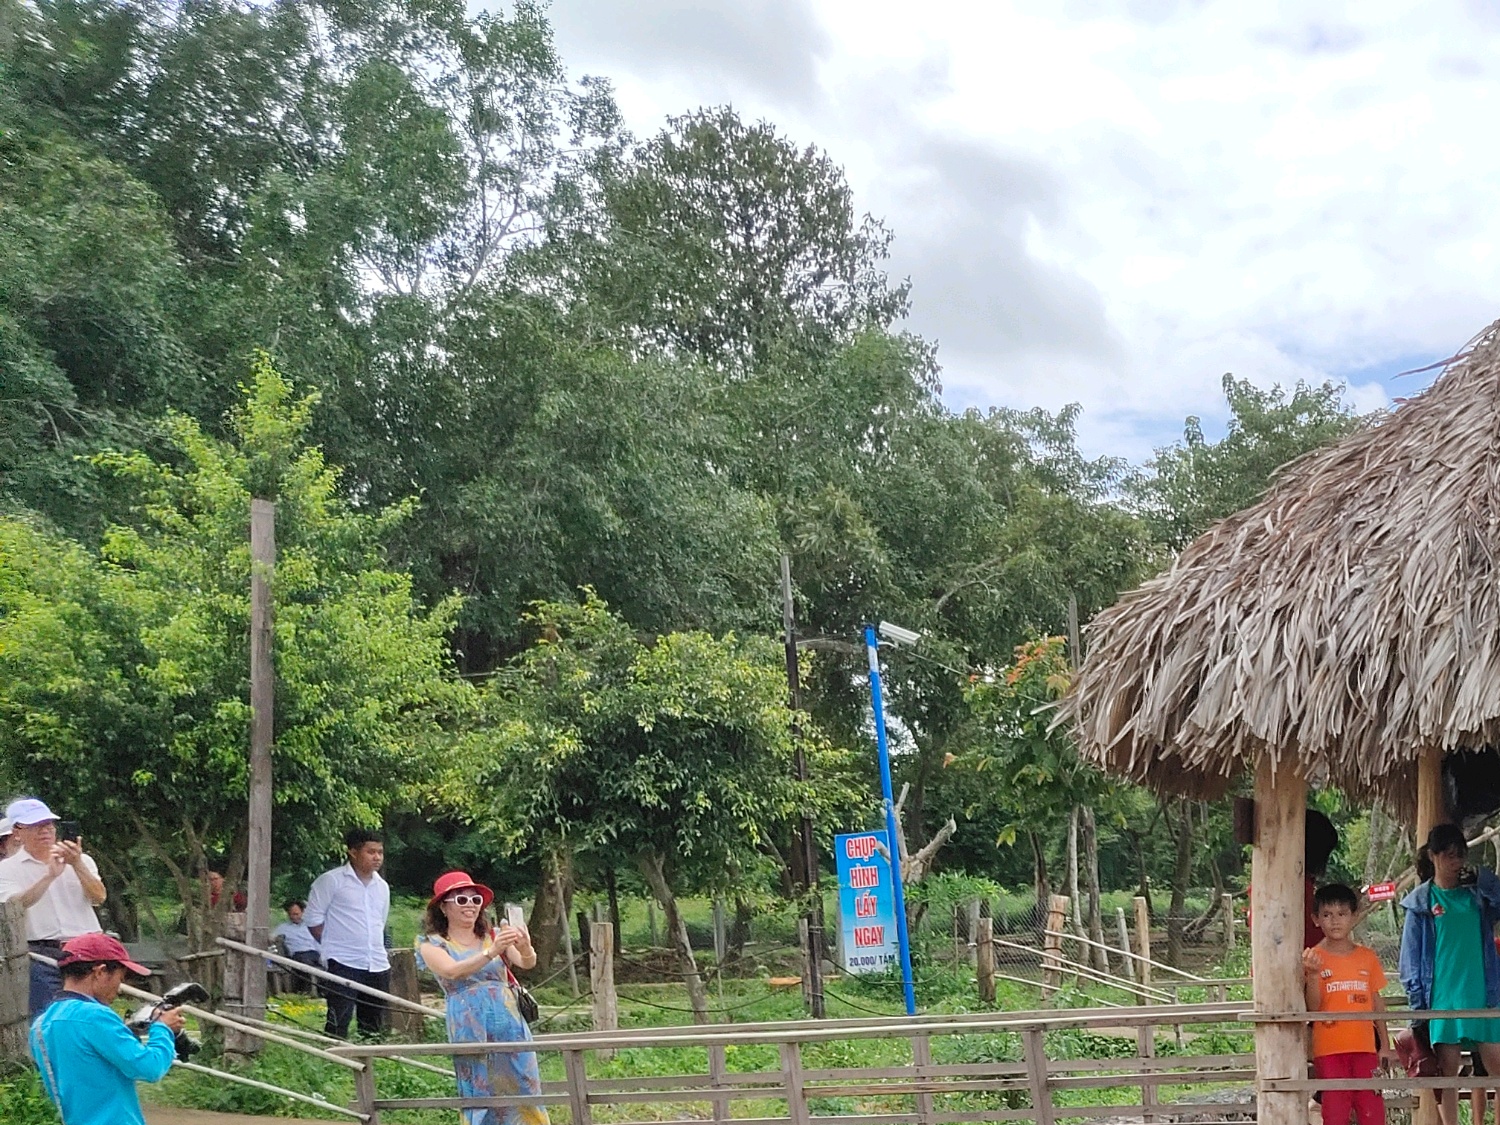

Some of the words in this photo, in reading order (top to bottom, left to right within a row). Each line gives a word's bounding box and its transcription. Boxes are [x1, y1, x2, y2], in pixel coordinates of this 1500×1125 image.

[846, 836, 877, 862] CHỤP
[850, 863, 879, 889] HÌNH
[856, 890, 877, 918] LẤY
[854, 926, 884, 948] NGAY
